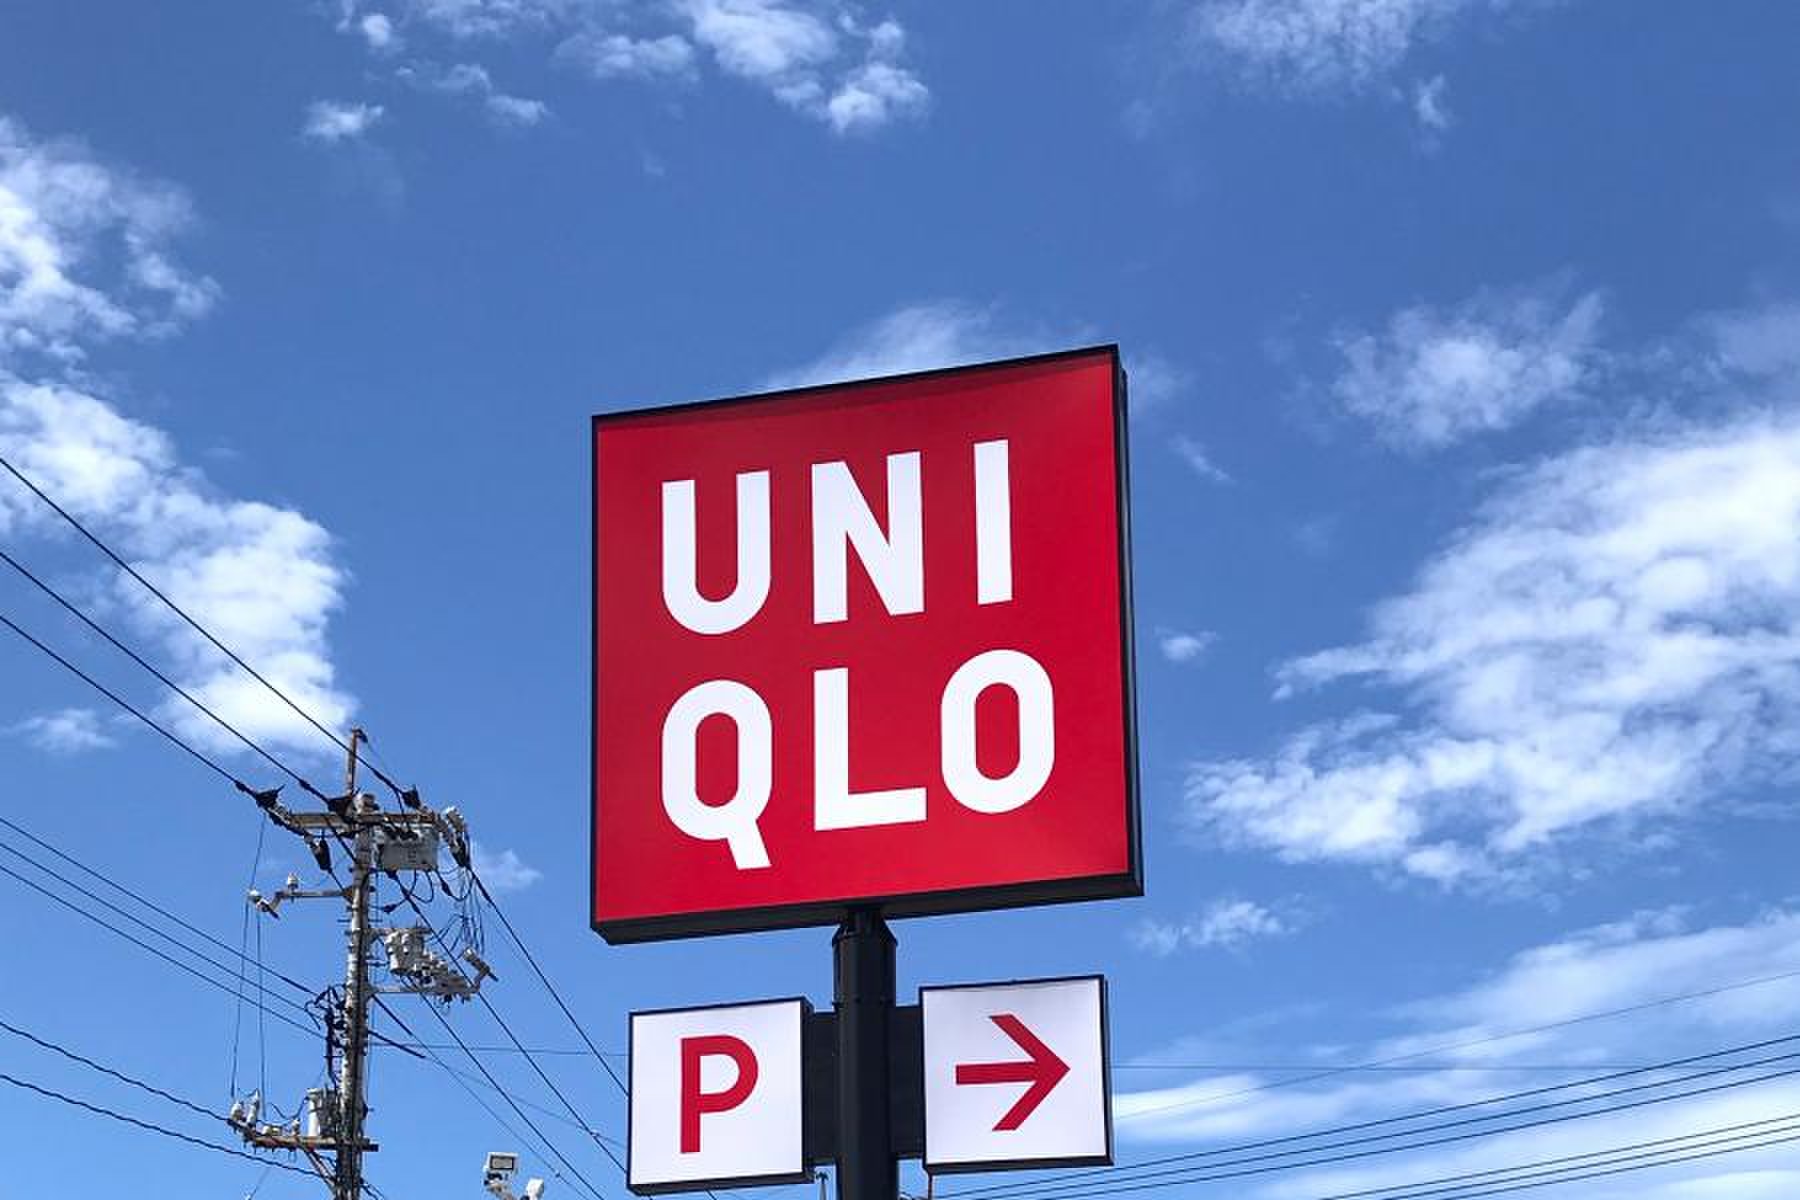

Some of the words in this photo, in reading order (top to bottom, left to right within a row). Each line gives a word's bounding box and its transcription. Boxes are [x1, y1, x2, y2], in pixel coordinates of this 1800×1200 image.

[662, 439, 1013, 635] UNI
[661, 649, 1055, 870] QLO
[680, 1034, 759, 1154] P
